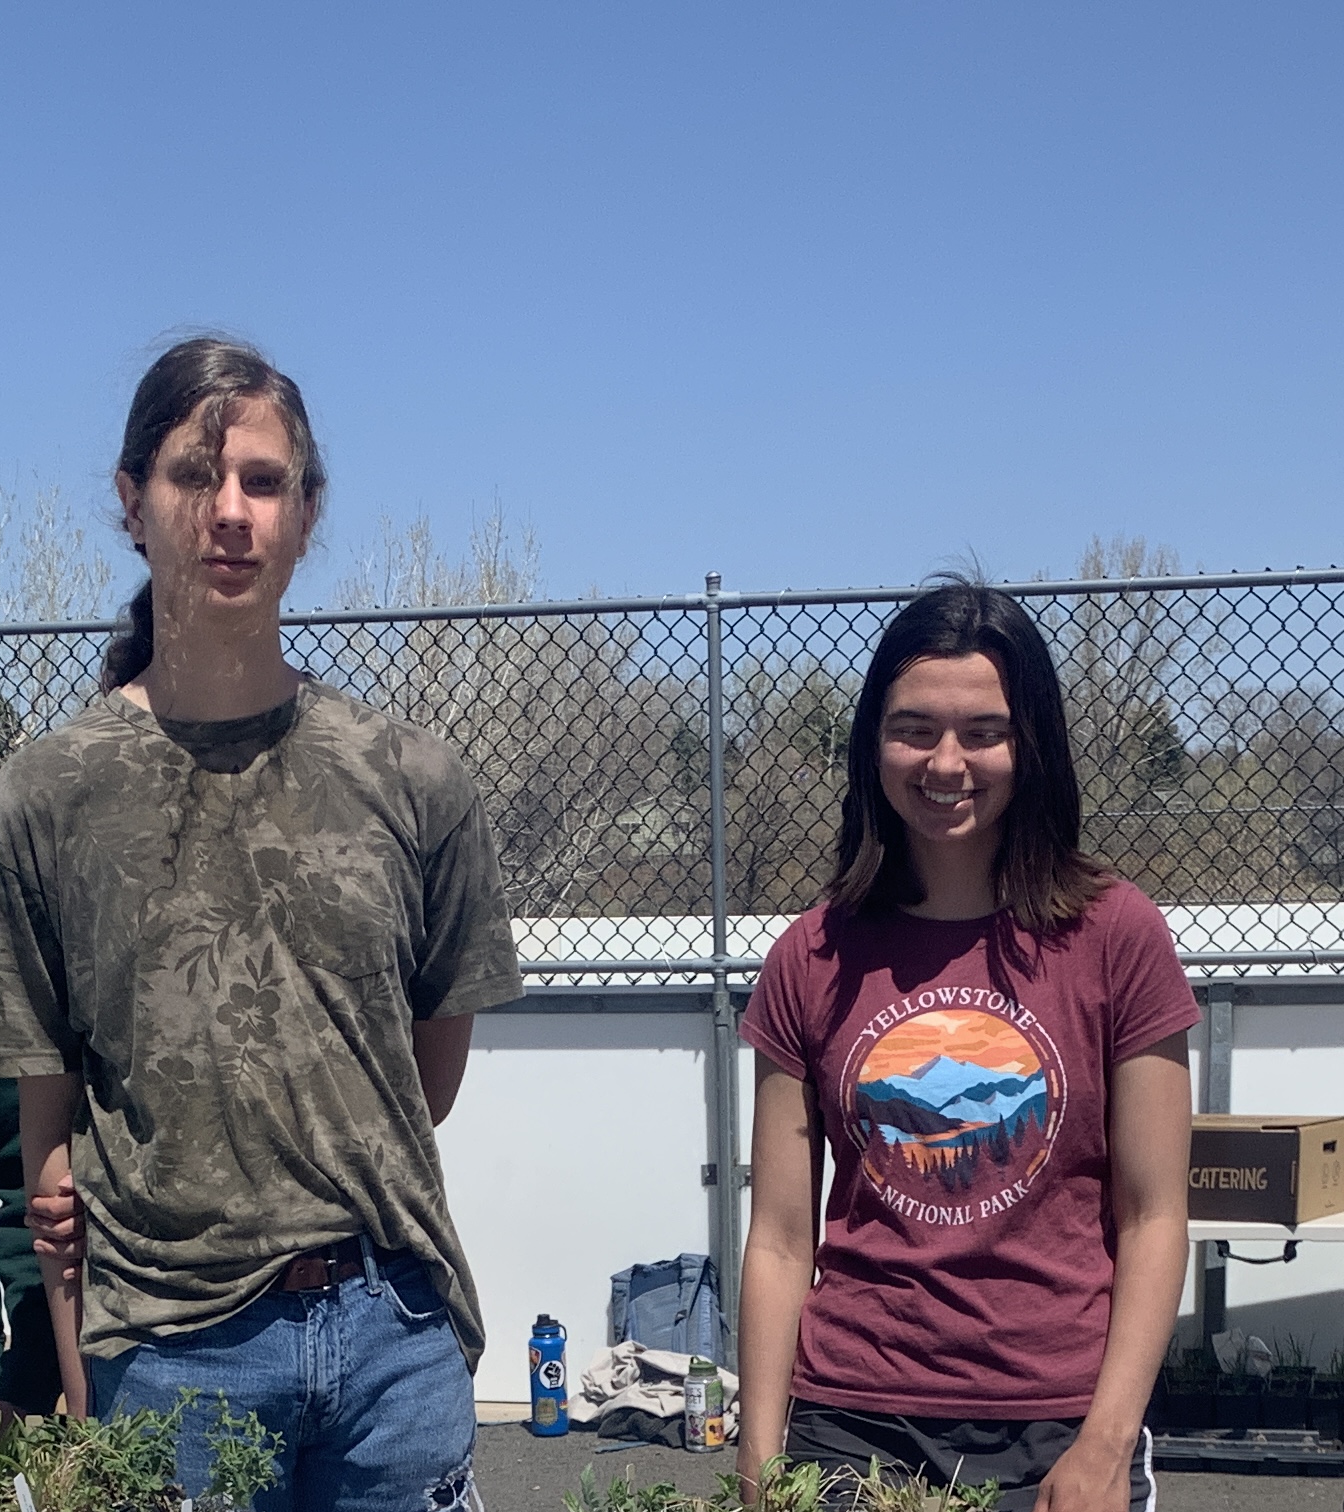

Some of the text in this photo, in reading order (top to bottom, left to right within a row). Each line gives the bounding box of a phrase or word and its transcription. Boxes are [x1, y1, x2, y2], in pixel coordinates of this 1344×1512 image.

[860, 986, 1037, 1040] YELLOWSTONE
[879, 1178, 1030, 1226] NATIONAL PARK
[1188, 1166, 1268, 1191] CATERING
